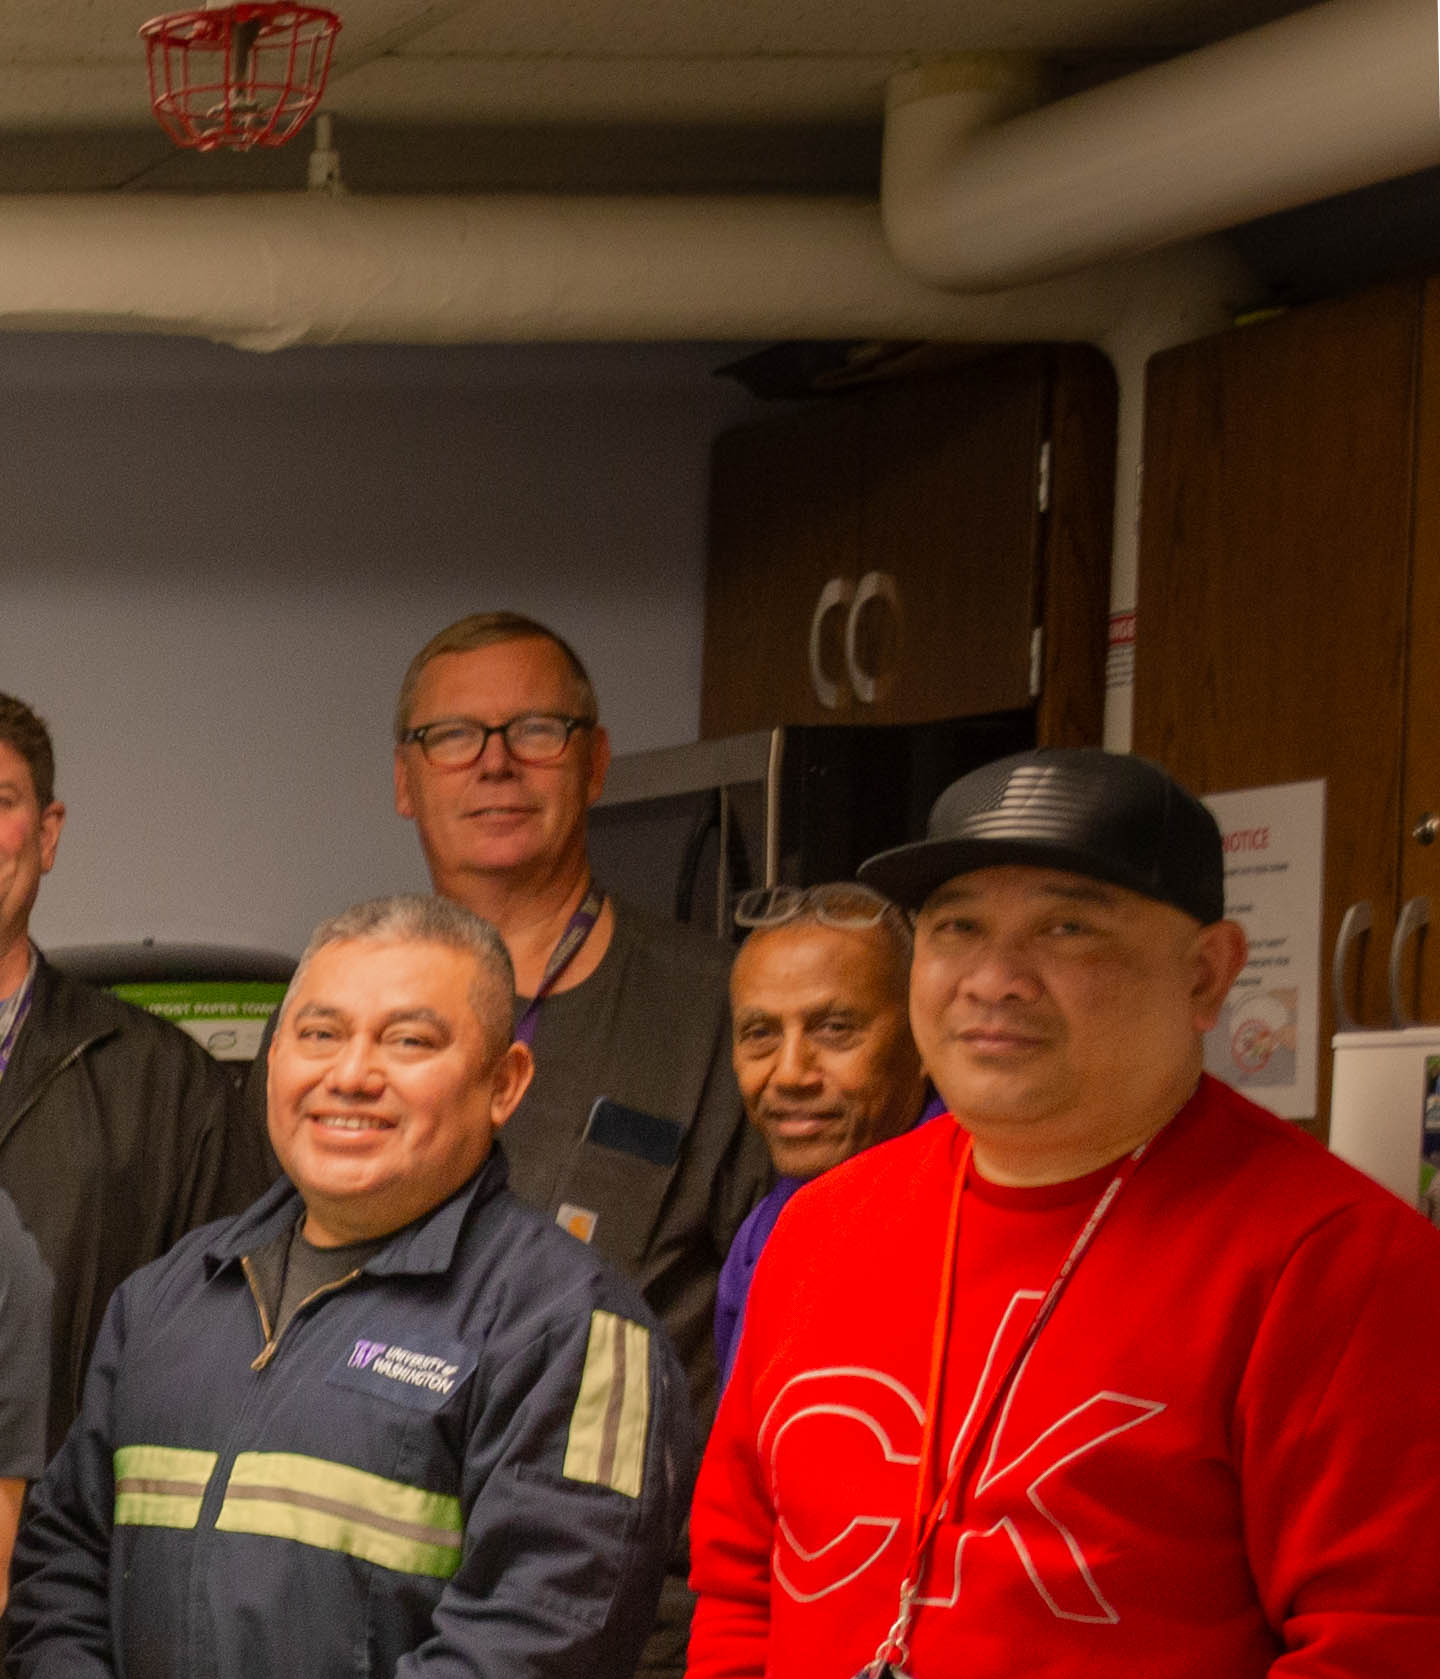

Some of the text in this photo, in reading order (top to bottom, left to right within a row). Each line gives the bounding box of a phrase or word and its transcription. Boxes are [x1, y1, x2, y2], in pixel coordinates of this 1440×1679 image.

[347, 1339, 388, 1369] W
[372, 1356, 456, 1395] WASHINGTON
[757, 1289, 1168, 1625] CK
